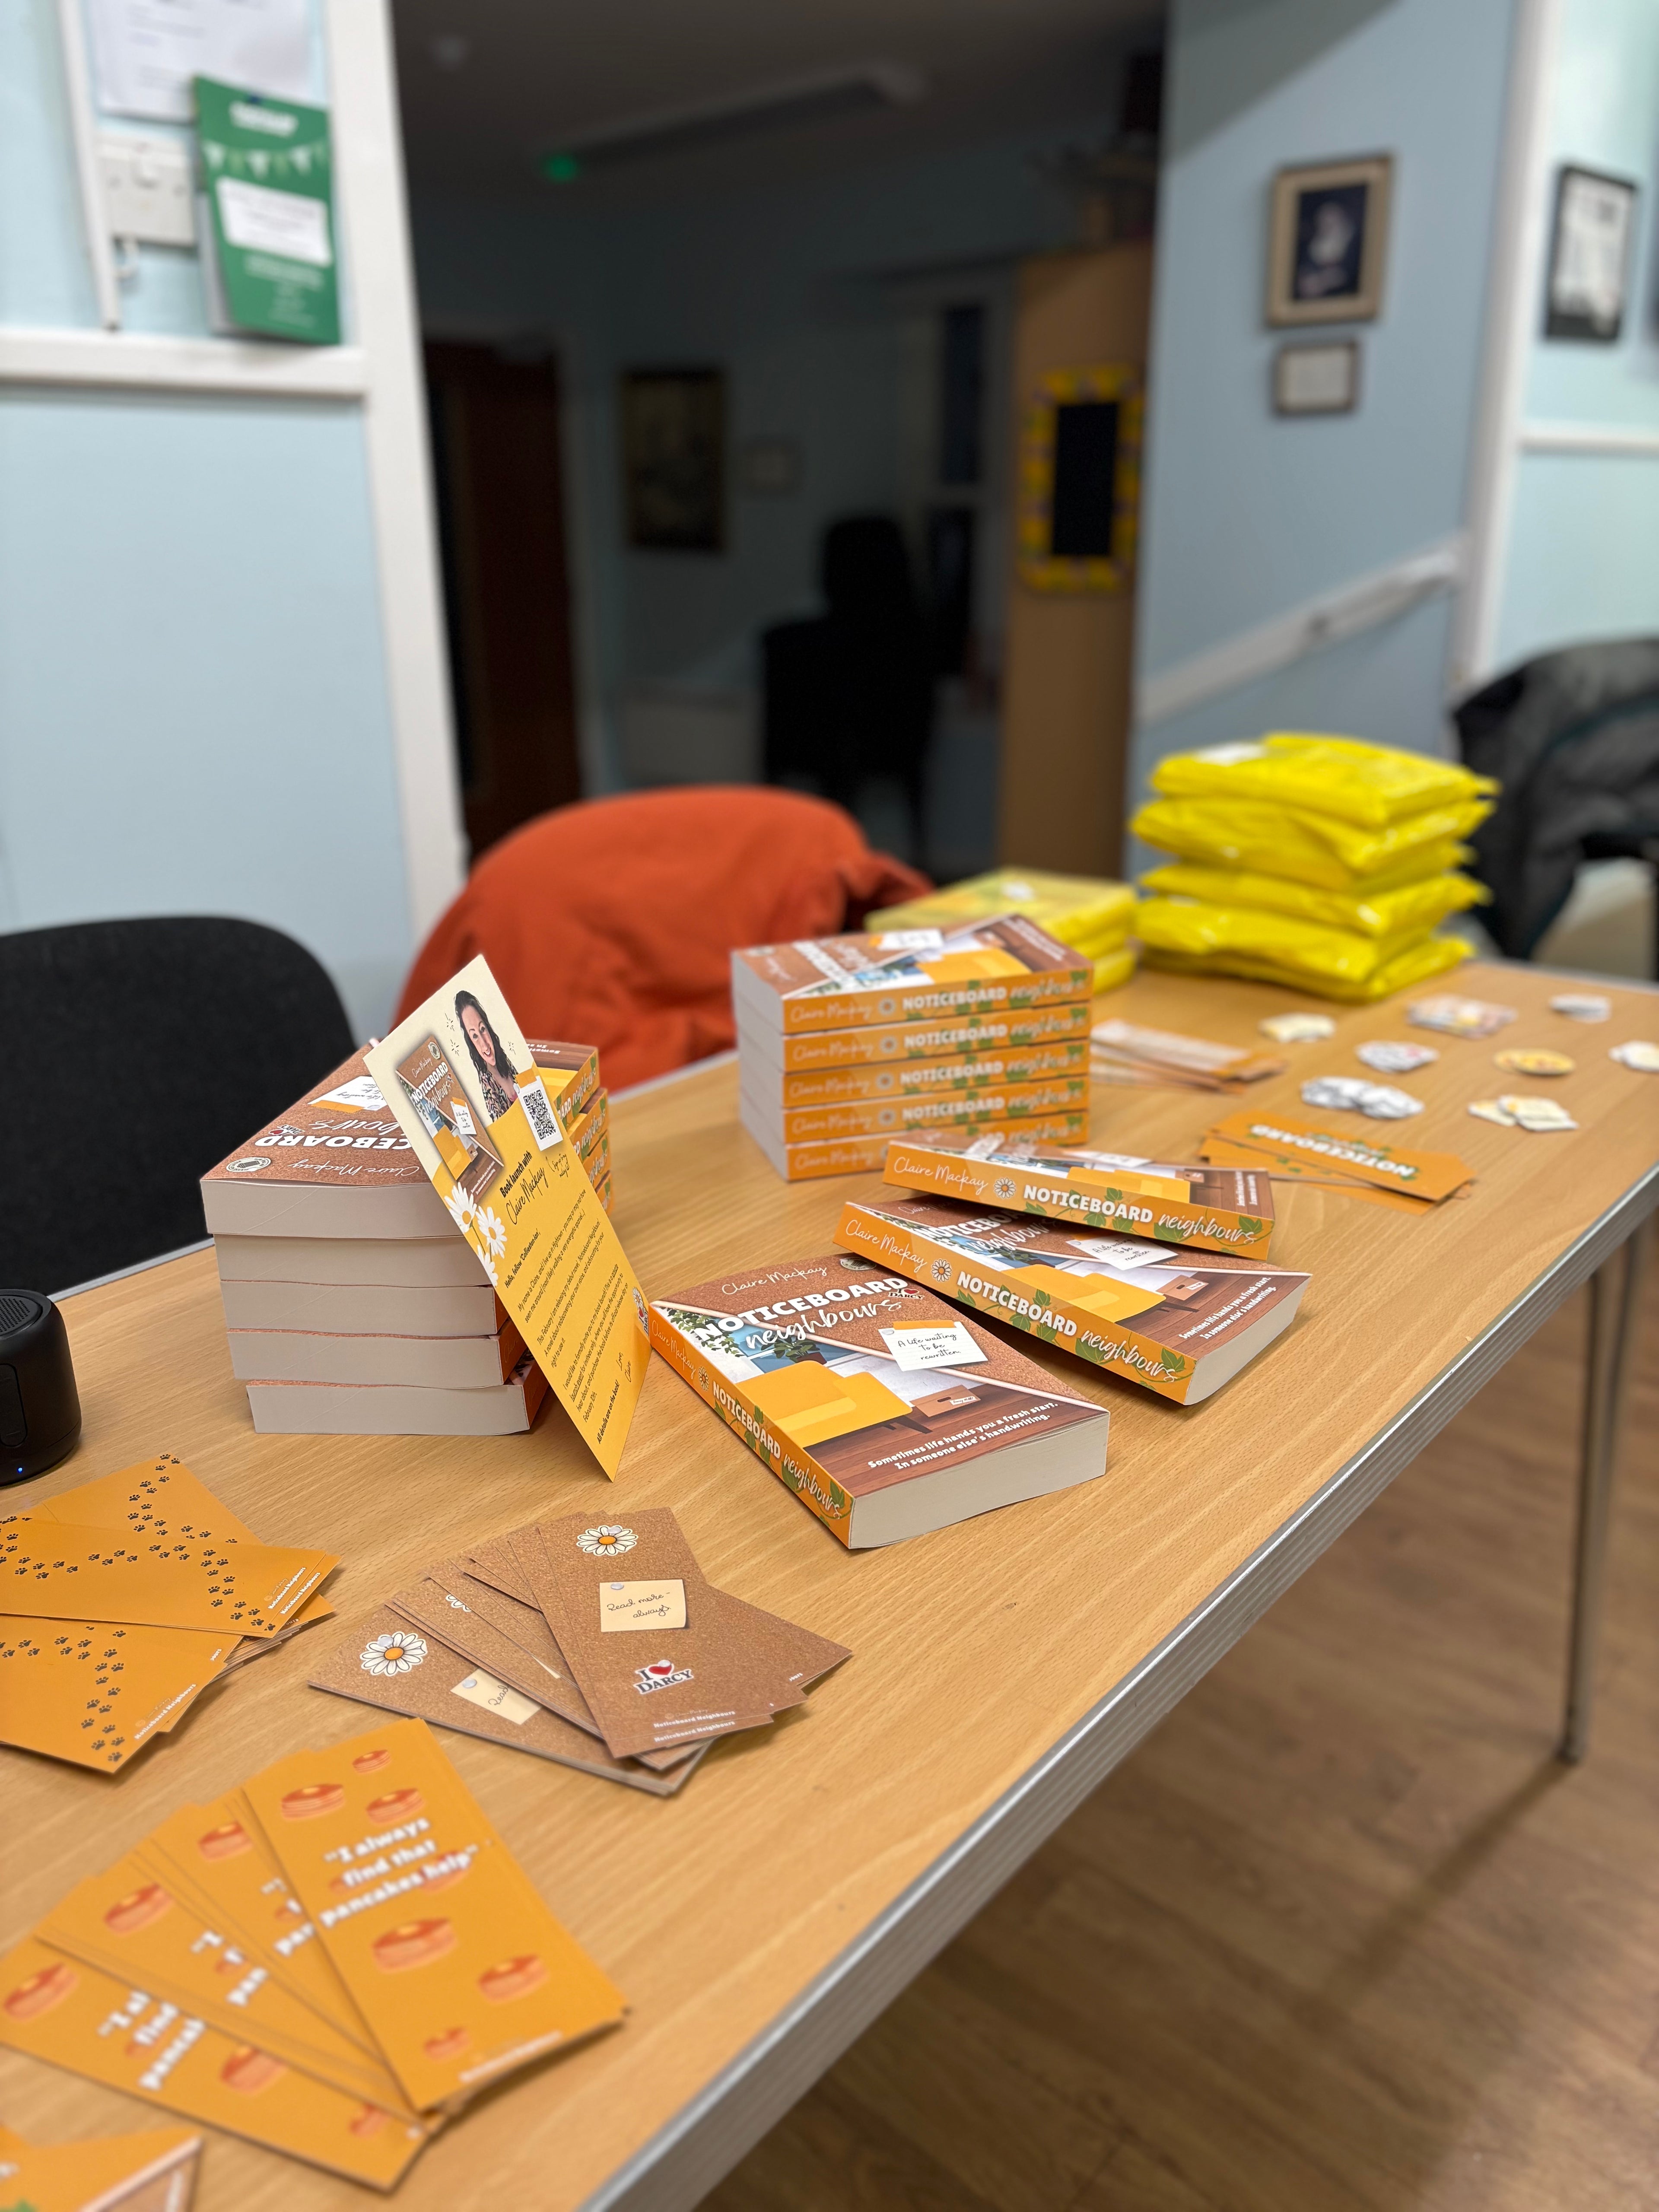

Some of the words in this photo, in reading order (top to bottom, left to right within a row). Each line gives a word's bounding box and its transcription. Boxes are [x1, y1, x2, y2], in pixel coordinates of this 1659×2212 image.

[903, 987, 1007, 1010] NOTICEBOARD
[904, 1024, 1007, 1049] NOTICEBOARD
[412, 1062, 448, 1104] NOTICEBOARD
[900, 1061, 1003, 1084] NOTICEBOARD
[903, 1097, 1005, 1121] NOTICEBOARD
[287, 1159, 363, 1175] Mackay
[364, 1165, 420, 1176] Claire
[1250, 1125, 1415, 1176] NOTICEBOARD
[499, 1179, 513, 1198] Book
[509, 1162, 524, 1184] launch
[522, 1150, 532, 1167] with
[506, 1196, 525, 1225] Claire
[520, 1167, 548, 1202] Mackay
[894, 1157, 933, 1177] Claire
[935, 1164, 988, 1195] Mackay
[1023, 1184, 1154, 1224] NOTICEBOARD
[1158, 1213, 1257, 1244] neighbours
[504, 1274, 515, 1288] Hello,
[512, 1260, 522, 1275] fellow
[518, 1302, 524, 1312] My
[522, 1290, 530, 1305] name
[530, 1274, 540, 1288] Claire,
[721, 1274, 767, 1295] Claire
[767, 1265, 827, 1284] Mackay
[694, 1278, 908, 1342] NOTICEBOARD
[845, 1219, 880, 1244] Claire
[880, 1235, 927, 1273] Mackay
[957, 1271, 1077, 1337] NOTICEBOARD
[1081, 1328, 1178, 1382] neighbours
[1179, 1321, 1210, 1339] Sometimes
[1209, 1315, 1219, 1325] life
[1216, 1305, 1232, 1319] hands
[1231, 1297, 1243, 1309] you
[1243, 1284, 1258, 1297] fresh
[1255, 1277, 1271, 1289] start.
[1209, 1318, 1234, 1334] someone
[1230, 1307, 1247, 1322] else's
[1244, 1286, 1277, 1311] handwriting.
[746, 1298, 903, 1350] neighbours
[925, 1333, 957, 1341] waiting
[921, 1349, 961, 1360] rewritten.
[599, 1417, 608, 1436] details
[651, 1319, 671, 1347] Claire
[669, 1338, 696, 1379] Mackay
[713, 1380, 781, 1459] NOTICEBOARD
[783, 1453, 842, 1520] neighbours
[868, 1445, 926, 1468] Sometimes
[925, 1439, 945, 1451] life
[944, 1429, 976, 1444] hands
[976, 1421, 997, 1433] you
[1001, 1409, 1030, 1423] fresh
[1030, 1402, 1058, 1415] start.
[894, 1460, 910, 1470] In
[911, 1445, 956, 1465] someone
[957, 1436, 987, 1450] else's
[985, 1414, 1051, 1441] handwriting.
[268, 1586, 289, 1609] Noticeboard
[286, 1567, 306, 1587] Neighbours
[280, 1592, 303, 1614] Noticeboard
[299, 1572, 321, 1592] Neighbours
[607, 1599, 635, 1611] Read
[638, 1594, 664, 1603] more
[633, 1605, 671, 1617] always.
[636, 1669, 692, 1693] DARCY
[639, 1669, 654, 1681] I
[134, 1709, 168, 1739] Noticeboard
[165, 1683, 197, 1710] Neighbours
[653, 1717, 696, 1728] Noticeboard
[696, 1710, 736, 1721] Neighbours
[654, 1729, 696, 1742] Noticeboard
[696, 1721, 736, 1733] Neighbours
[355, 1817, 430, 1857] always
[342, 1857, 391, 1887] find
[391, 1839, 436, 1866] that
[319, 1871, 424, 1928] pancakes
